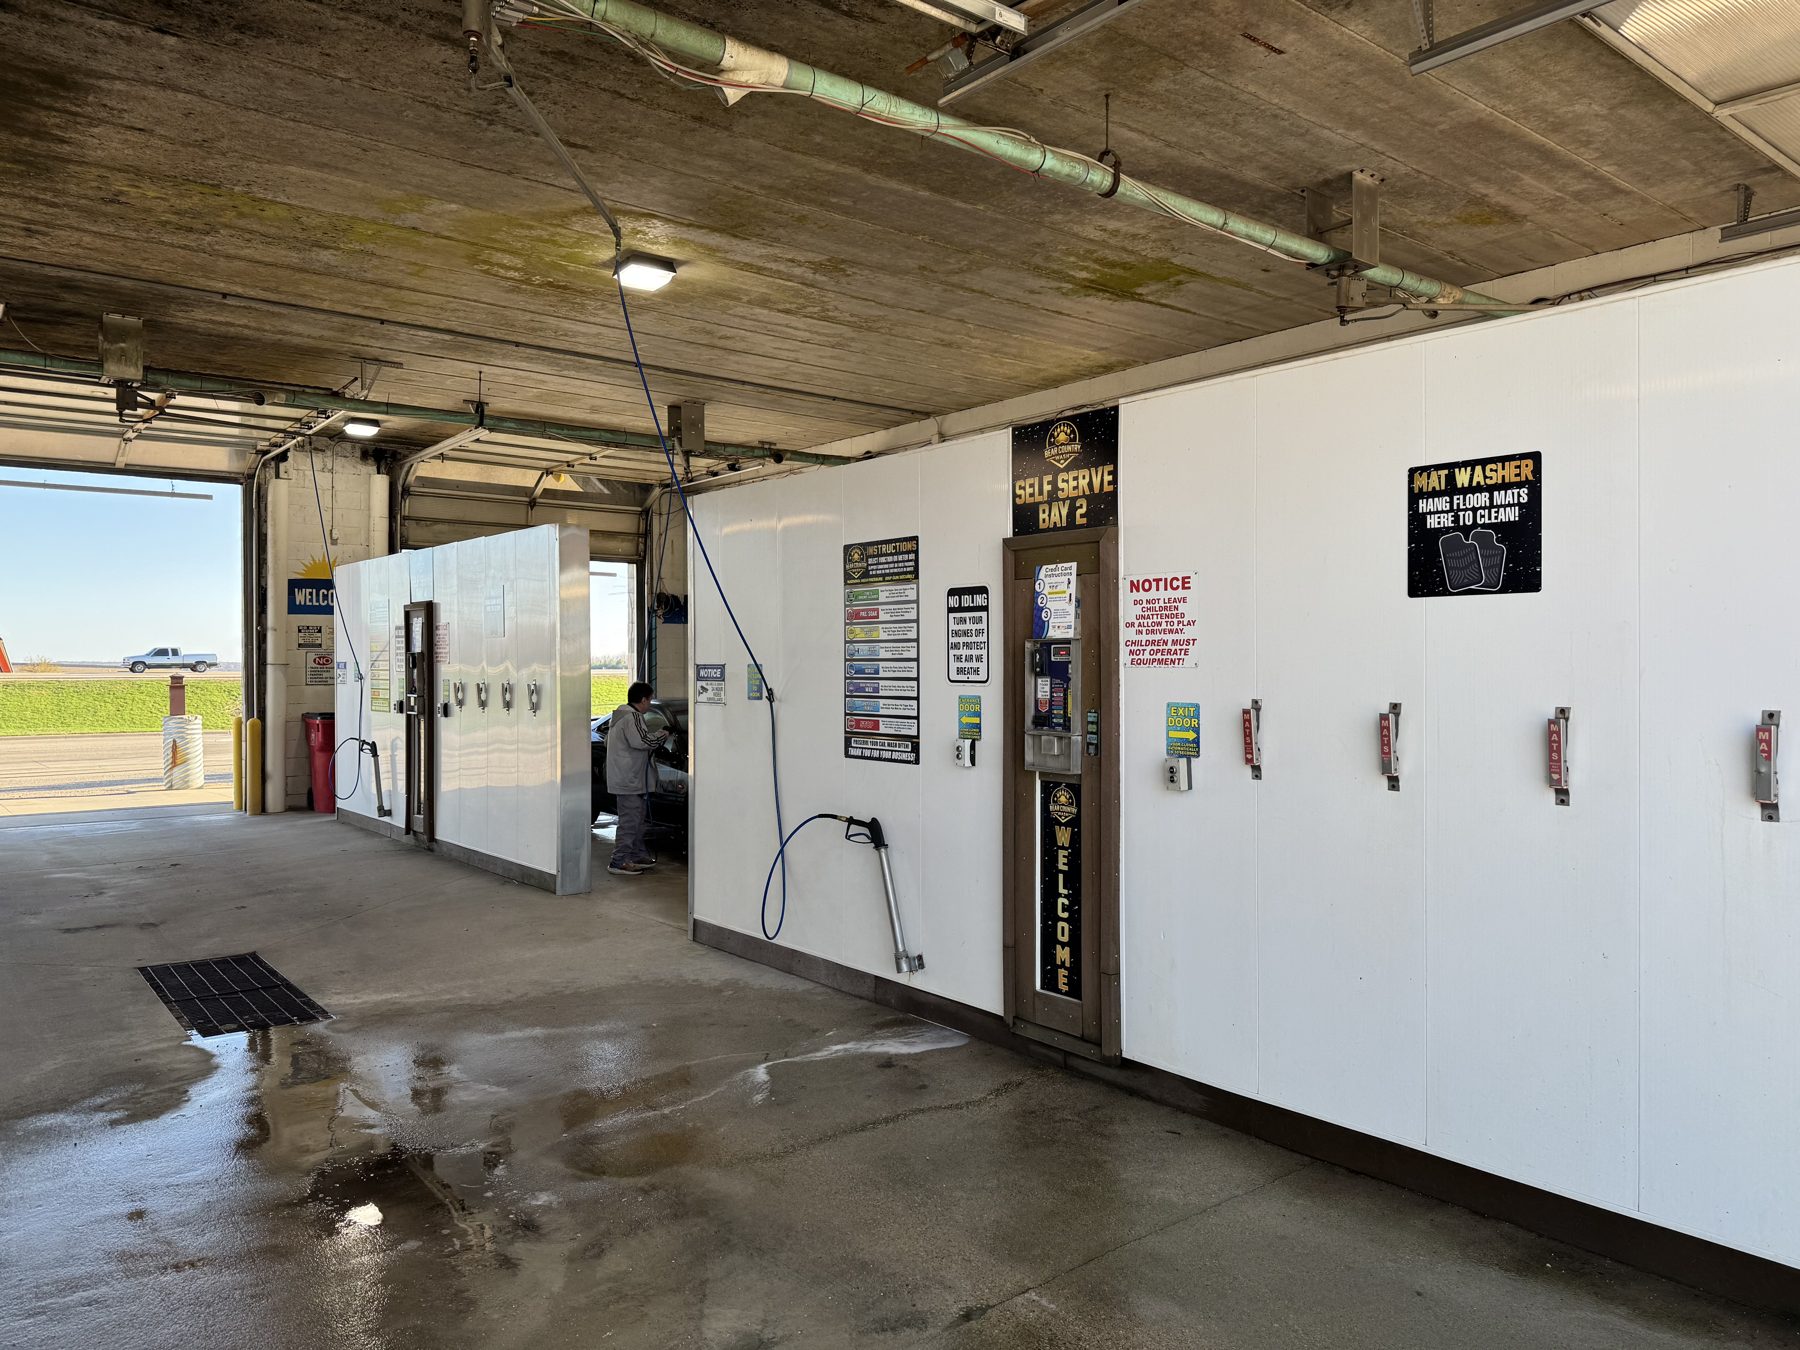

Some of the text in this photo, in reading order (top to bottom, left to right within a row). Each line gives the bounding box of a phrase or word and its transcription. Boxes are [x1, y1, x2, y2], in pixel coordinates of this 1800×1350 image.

[1045, 445, 1081, 457] BEAR COUNTRY
[1413, 459, 1534, 493] MAT WASHER
[1016, 464, 1114, 504] SELF SERVE
[1419, 488, 1528, 513] HANG FLOOR MATS
[1039, 498, 1087, 529] BAY 2
[1426, 506, 1519, 528] HERE TO CLEAN!
[867, 541, 917, 556] INSTRUCTIONS
[1045, 565, 1059, 573] Credit
[1130, 576, 1191, 593] NOTICE
[949, 594, 987, 607] NO IDLING
[1040, 596, 1044, 604] 2
[1141, 605, 1178, 613] CHILDREN
[1044, 610, 1048, 619] 3
[953, 616, 983, 625] TURN YOUR
[951, 629, 985, 637] ENGINES OFF
[950, 641, 986, 650] AND PROTECT
[1125, 639, 1168, 647] CHILDREN
[1149, 648, 1189, 656] OPERATE
[953, 654, 983, 663] THE AIR WE
[1130, 658, 1184, 666] EQUIPMENT!
[700, 669, 721, 677] NOTICE
[957, 667, 980, 675] BREATHE
[1171, 707, 1195, 716] EXIT
[1168, 718, 1198, 727] DOOR
[1550, 724, 1558, 760] MATS
[849, 748, 916, 761] THANK YOU FOR YOUR BUSINESS!
[1055, 825, 1071, 992] WELCOME
